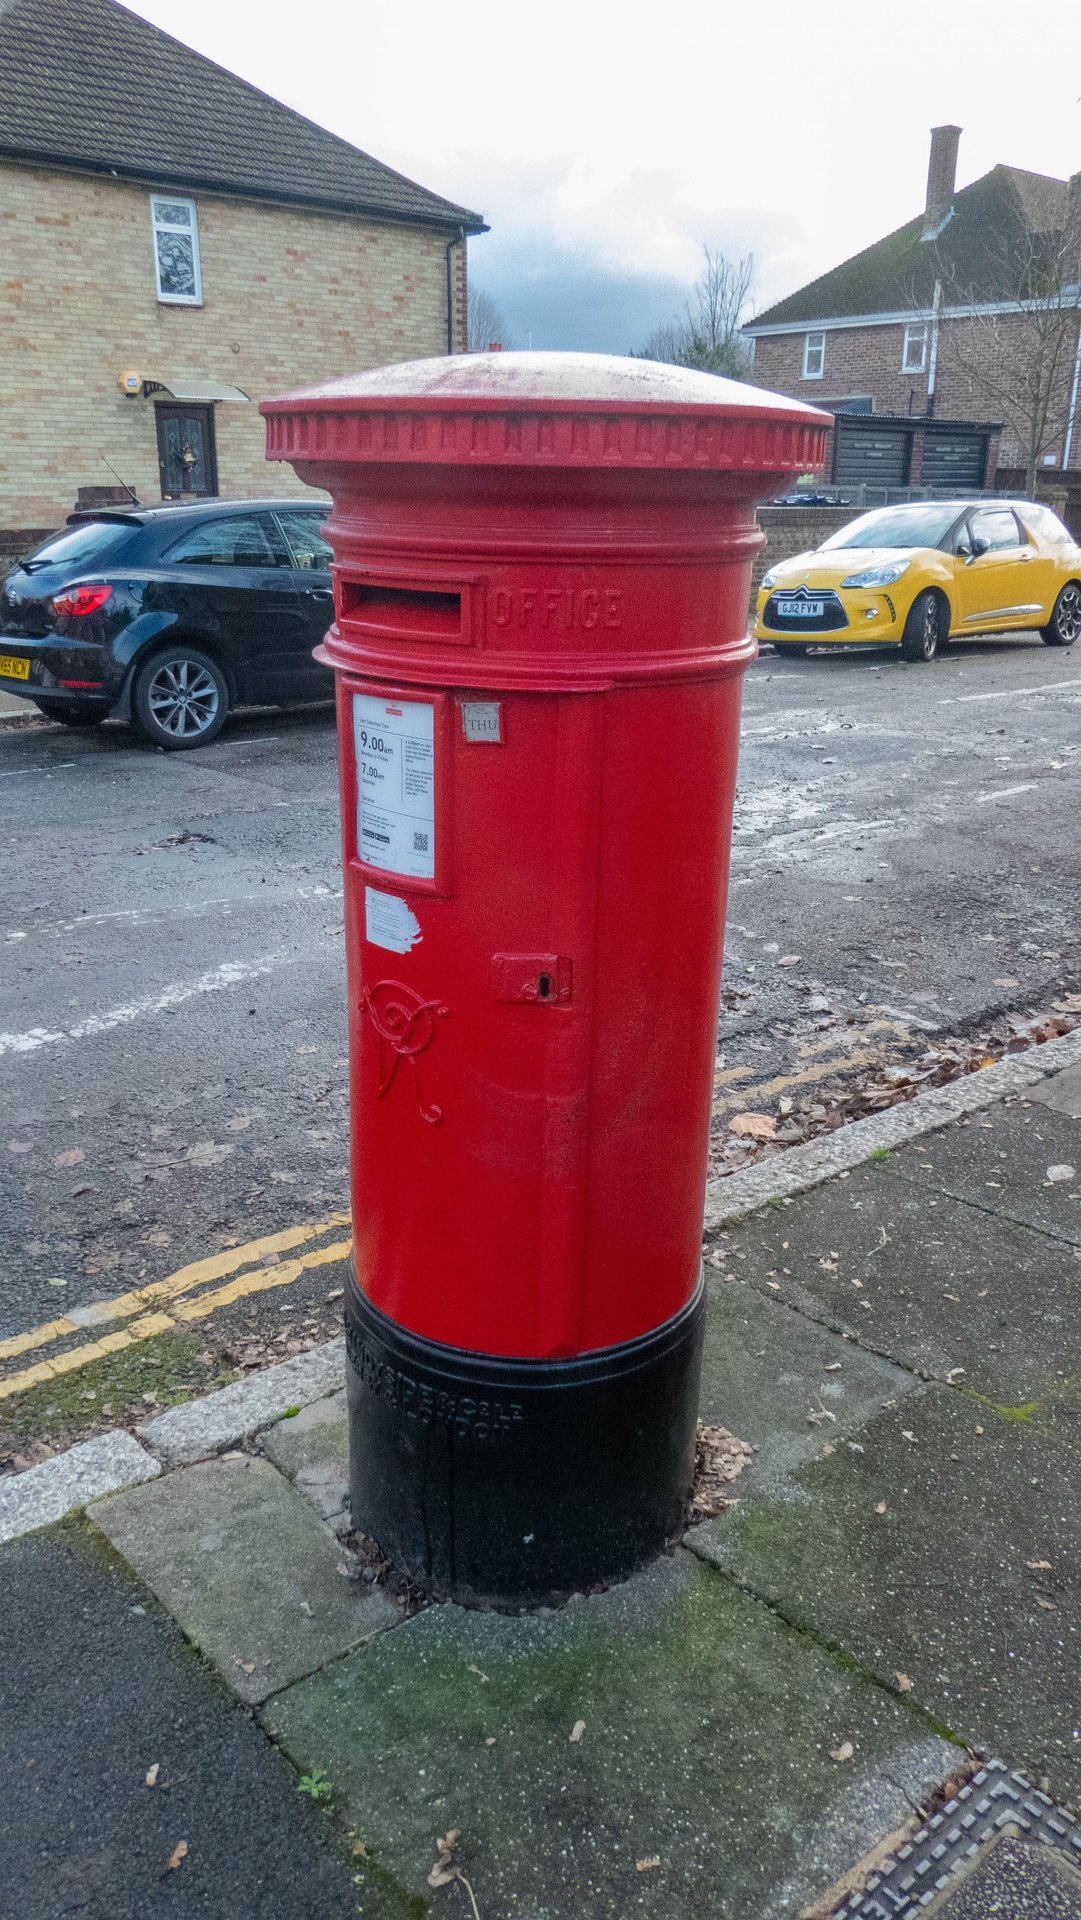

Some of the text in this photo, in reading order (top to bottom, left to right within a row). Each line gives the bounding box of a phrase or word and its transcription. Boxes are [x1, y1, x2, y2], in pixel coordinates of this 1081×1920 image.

[488, 586, 623, 630] OFFICE
[782, 603, 818, 613] GJ12 FVW
[468, 719, 498, 731] THU
[360, 731, 394, 755] 9.00am
[854, 1886, 911, 1920] TE
